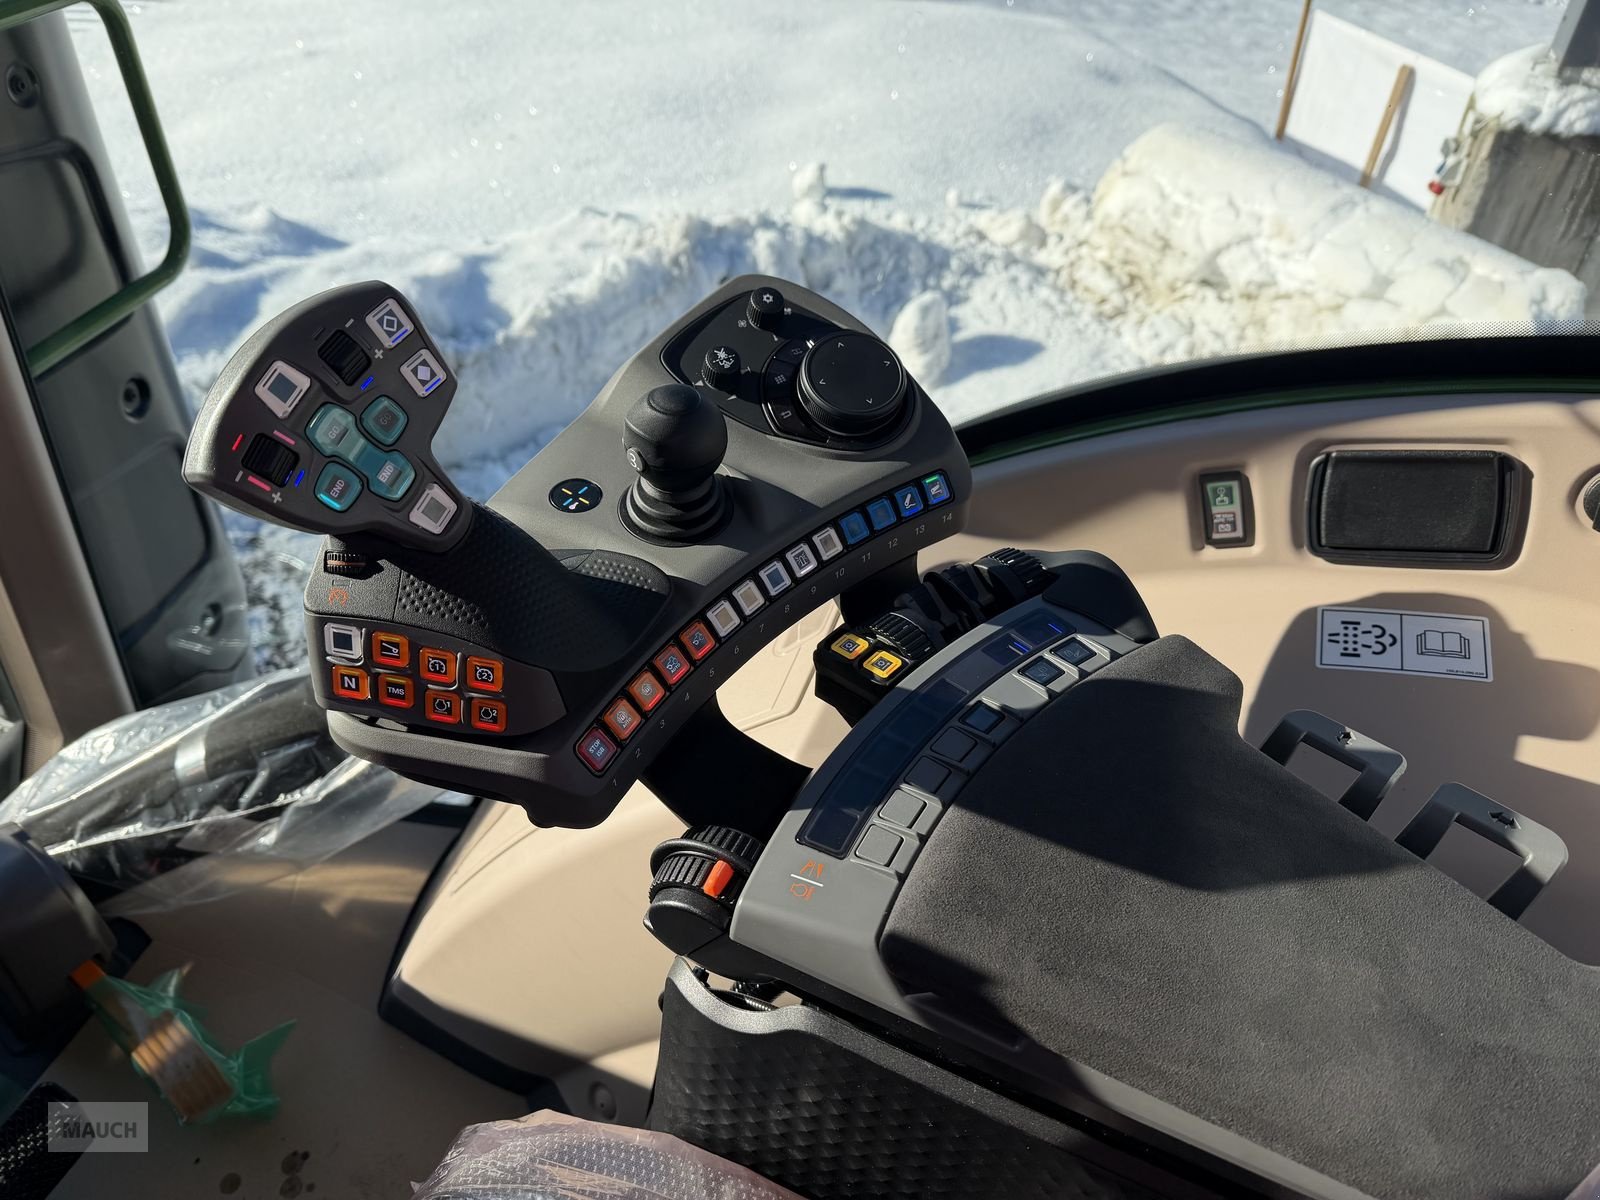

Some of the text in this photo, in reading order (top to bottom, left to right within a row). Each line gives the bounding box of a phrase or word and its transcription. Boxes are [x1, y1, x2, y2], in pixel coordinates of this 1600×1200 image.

[327, 425, 340, 440] GO
[378, 464, 394, 483] END
[329, 479, 345, 498] END
[942, 512, 953, 523] 14
[914, 524, 925, 536] 13
[887, 537, 898, 549] 12
[861, 551, 872, 563] 11
[834, 567, 845, 579] 10
[343, 676, 356, 689] N
[387, 686, 405, 696] TMS
[588, 738, 601, 754] STOP
